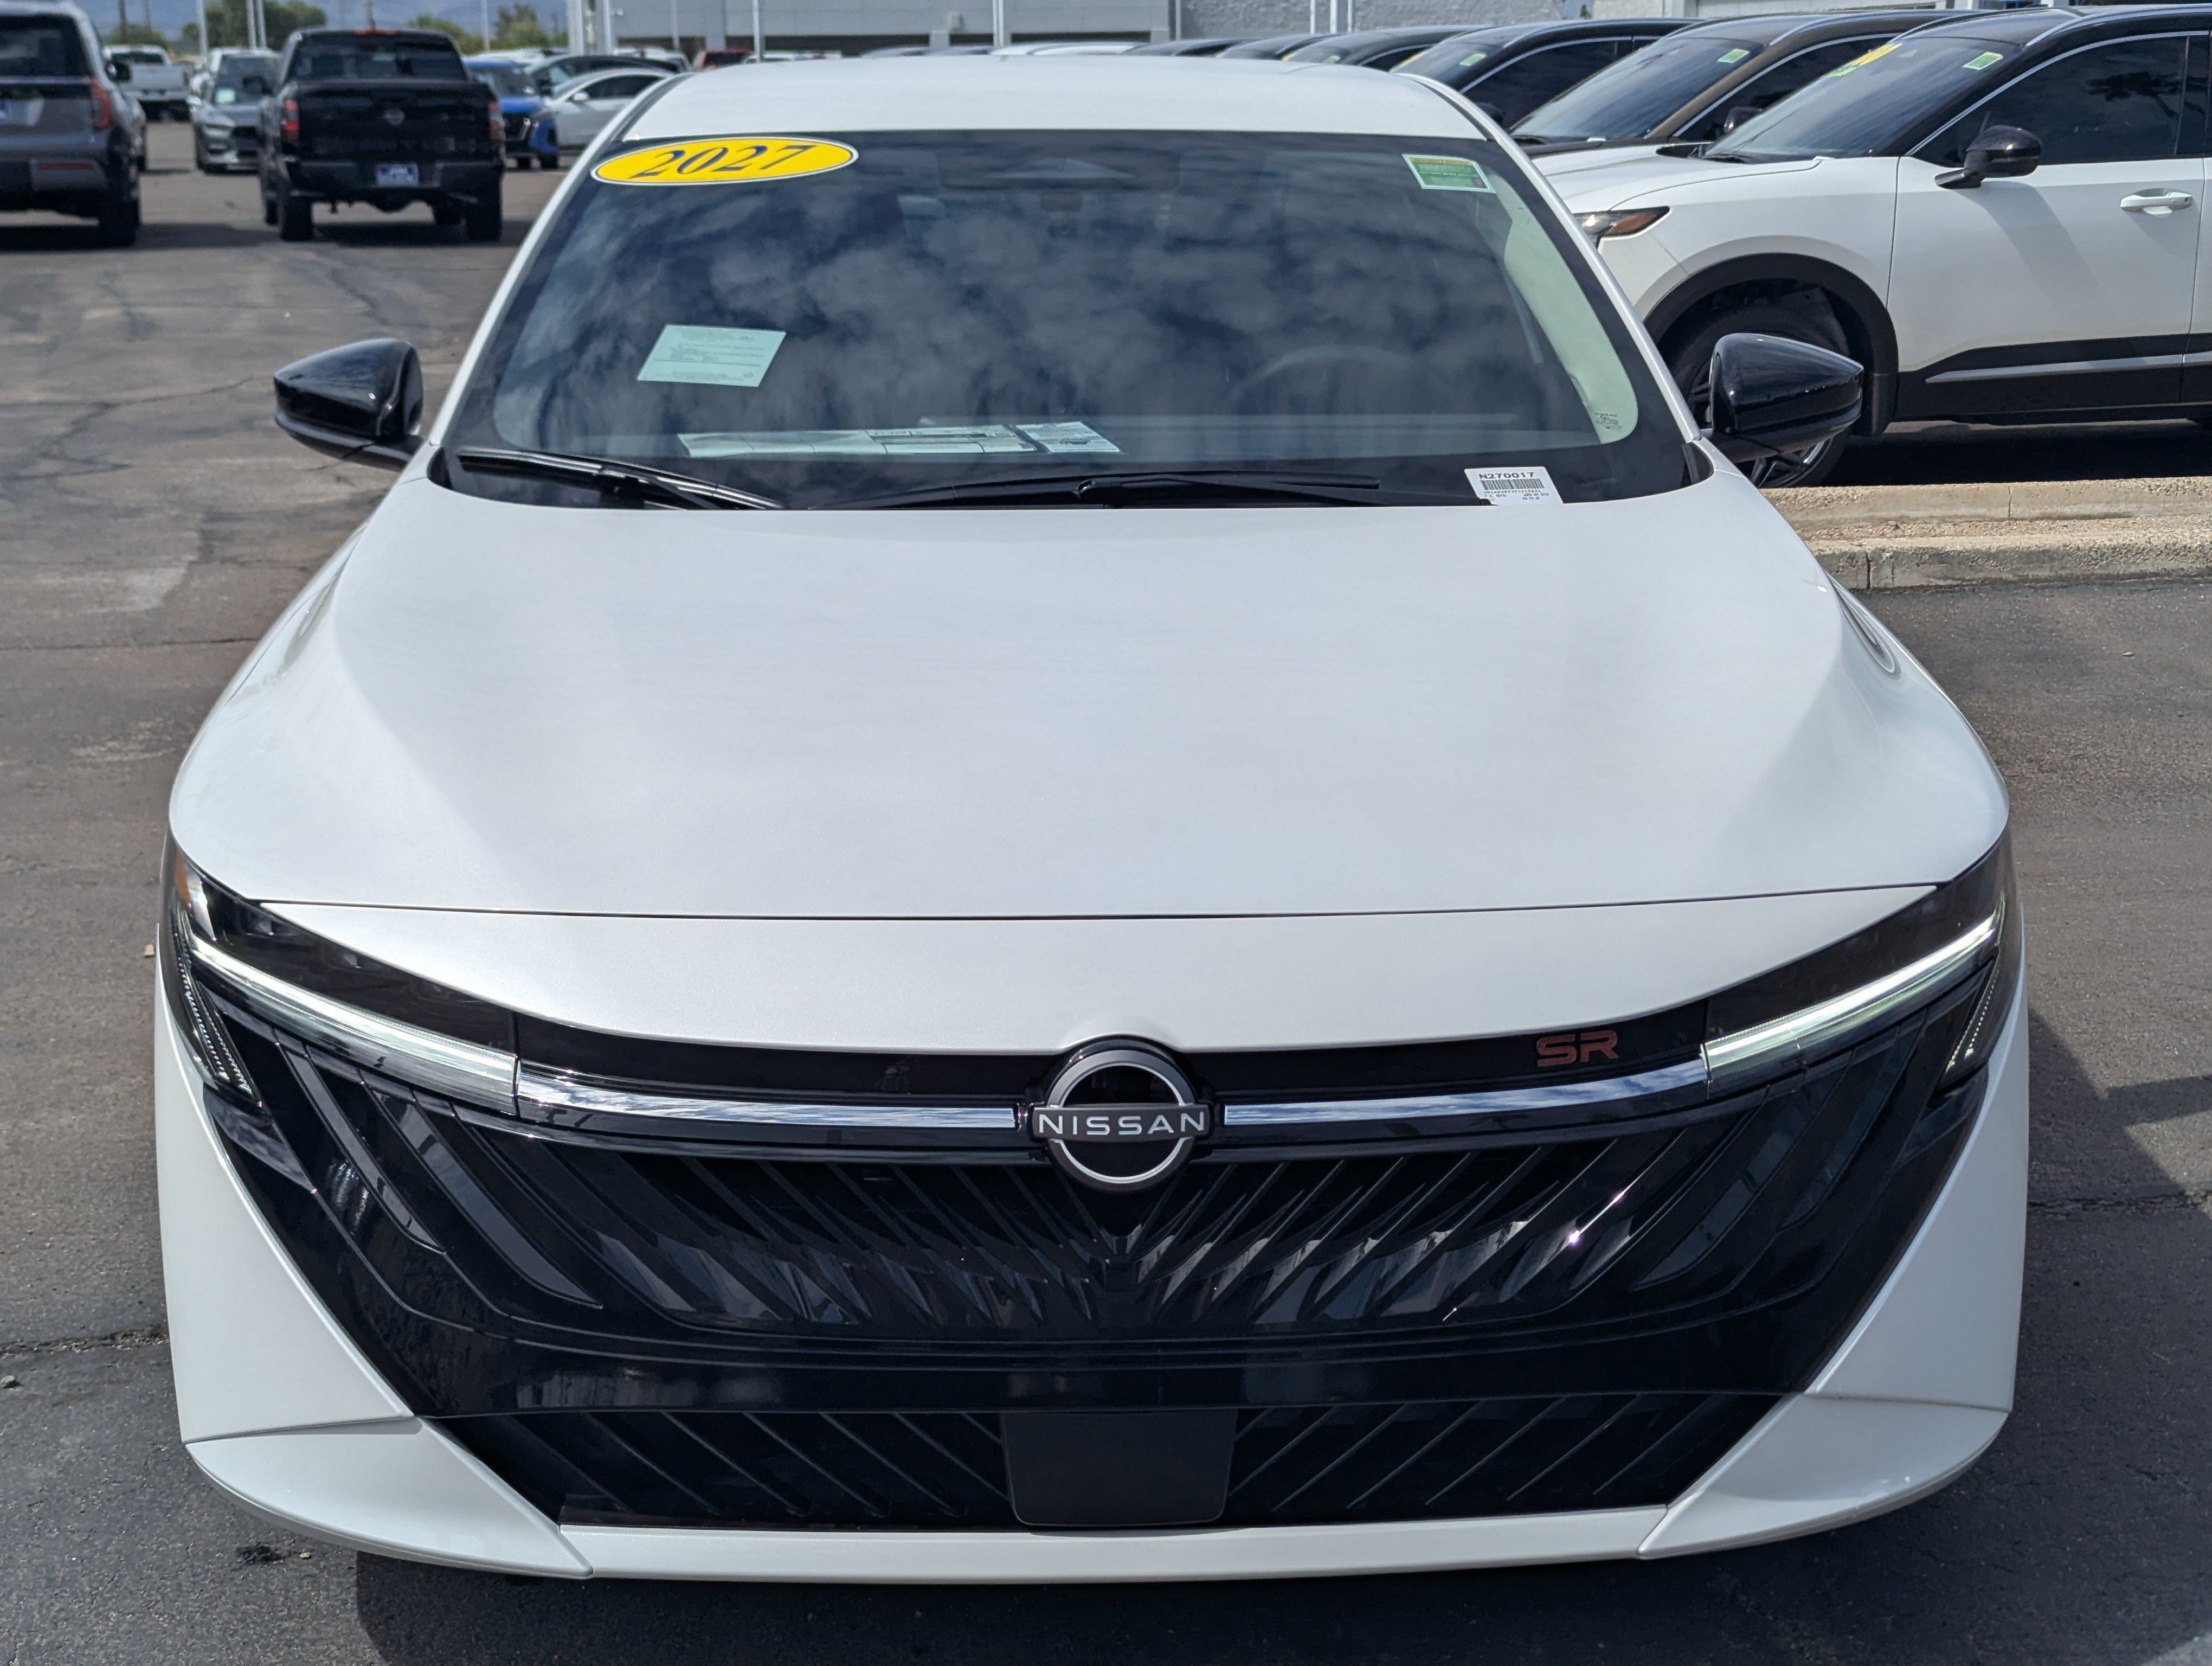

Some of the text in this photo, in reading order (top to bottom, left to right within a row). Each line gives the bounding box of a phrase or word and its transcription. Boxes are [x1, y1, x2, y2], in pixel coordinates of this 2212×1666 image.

[628, 145, 817, 179] 2027
[1536, 1030, 1619, 1067] SR
[1039, 1111, 1204, 1135] NISSAN
